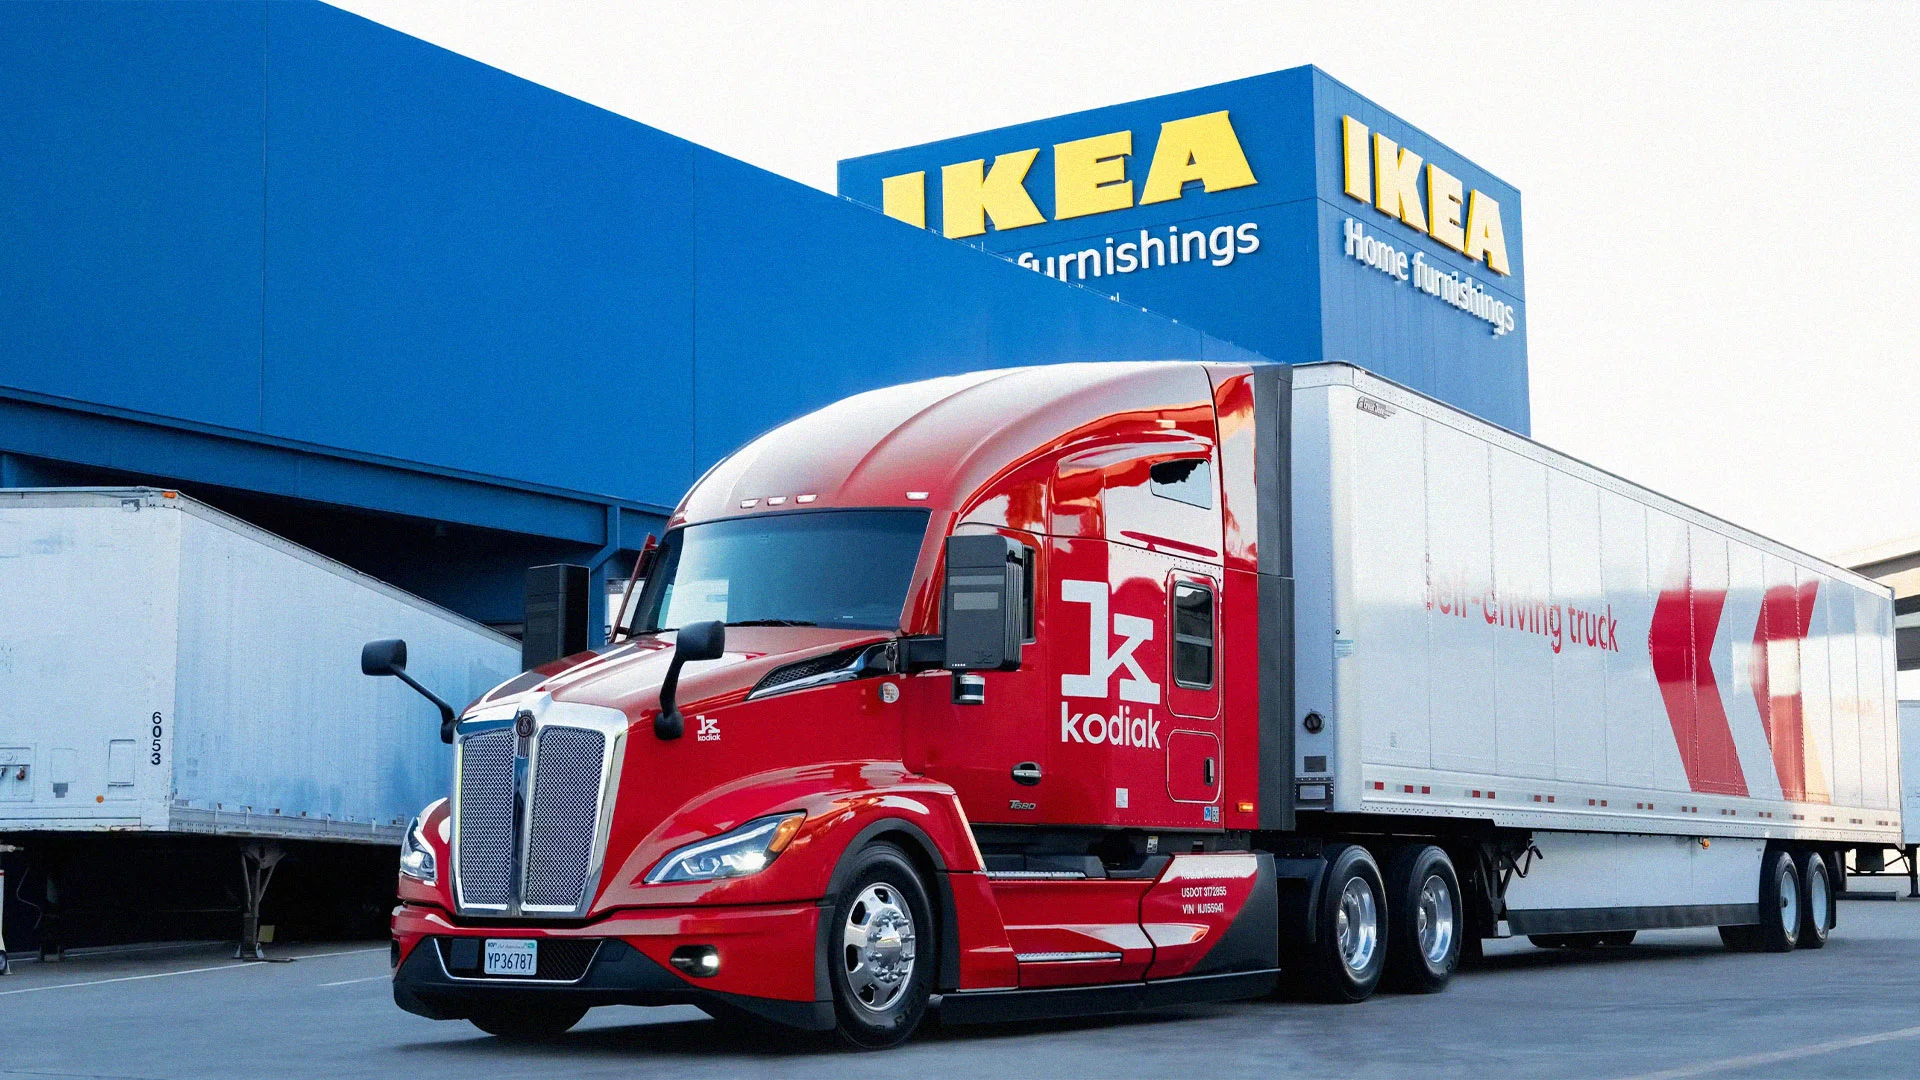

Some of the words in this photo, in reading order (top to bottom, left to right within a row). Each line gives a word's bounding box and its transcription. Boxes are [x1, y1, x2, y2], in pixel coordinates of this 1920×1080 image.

[882, 110, 1258, 239] IKEA
[1343, 115, 1511, 276] IKEA
[1344, 218, 1408, 281] Home
[1412, 251, 1515, 336] furnishings
[1567, 603, 1618, 652] truck
[151, 711, 162, 766] 6053
[697, 733, 721, 742] kodiak
[1061, 701, 1161, 749] kodiak
[1181, 886, 1203, 898] USDOT
[1182, 904, 1195, 915] VIN
[488, 952, 533, 970] YP36787
